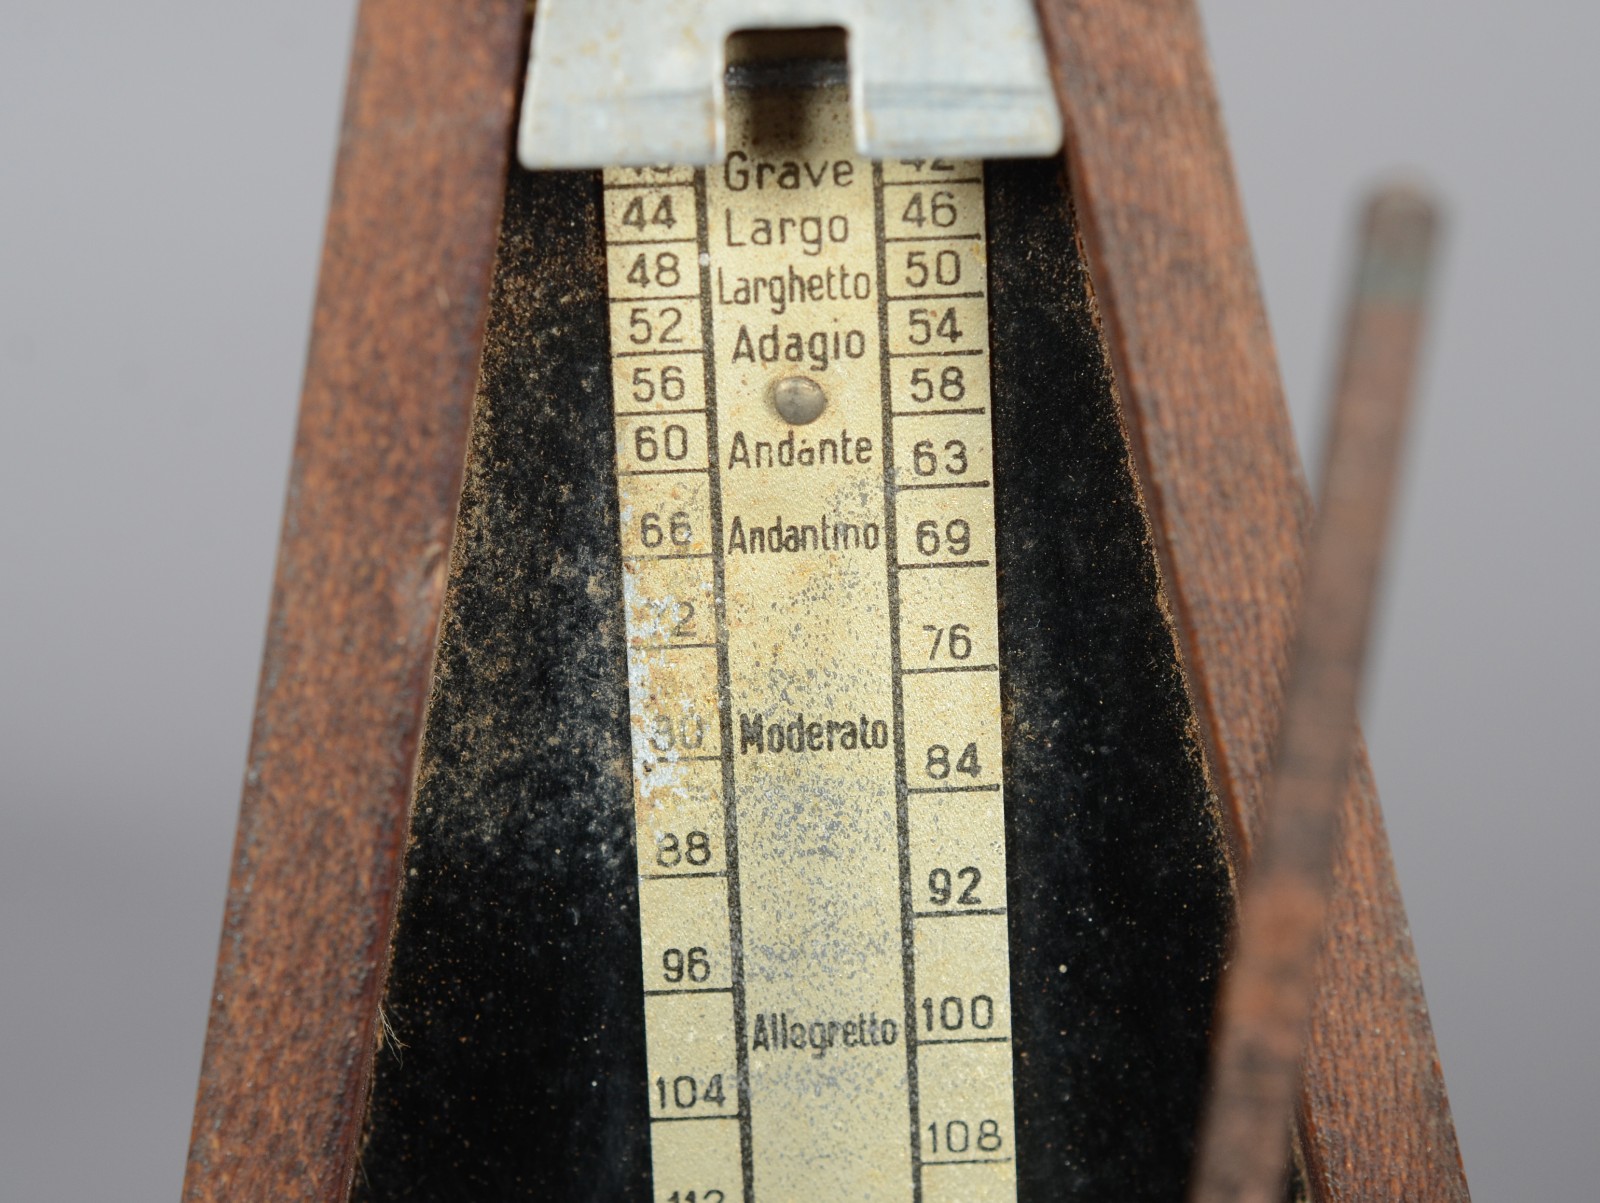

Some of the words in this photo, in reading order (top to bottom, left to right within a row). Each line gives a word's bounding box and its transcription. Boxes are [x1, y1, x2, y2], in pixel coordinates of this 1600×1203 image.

[724, 151, 854, 192] Grave
[621, 195, 677, 230] 44
[901, 191, 958, 228] 46
[725, 208, 850, 256] Largo
[626, 252, 681, 288] 48
[905, 250, 961, 288] 50
[718, 265, 871, 314] Larghetto
[629, 307, 683, 345] 52
[908, 307, 963, 345] 54
[731, 324, 866, 371] Adagio
[632, 365, 686, 402] 56
[910, 366, 966, 402] 58
[634, 424, 689, 462] 60
[727, 430, 874, 470] Andante
[912, 439, 968, 476] 63
[640, 511, 693, 548] 66
[726, 515, 881, 554] Andantino
[915, 519, 972, 556] 69
[922, 623, 973, 661] 76
[739, 712, 889, 755] Moderato
[925, 742, 982, 780] 84
[656, 830, 711, 868] 88
[928, 866, 982, 906] 92
[662, 947, 711, 983] 96
[921, 994, 995, 1032] 100
[752, 1012, 898, 1059] Allegretto
[656, 1073, 726, 1110] 104
[926, 1118, 1003, 1154] 108
